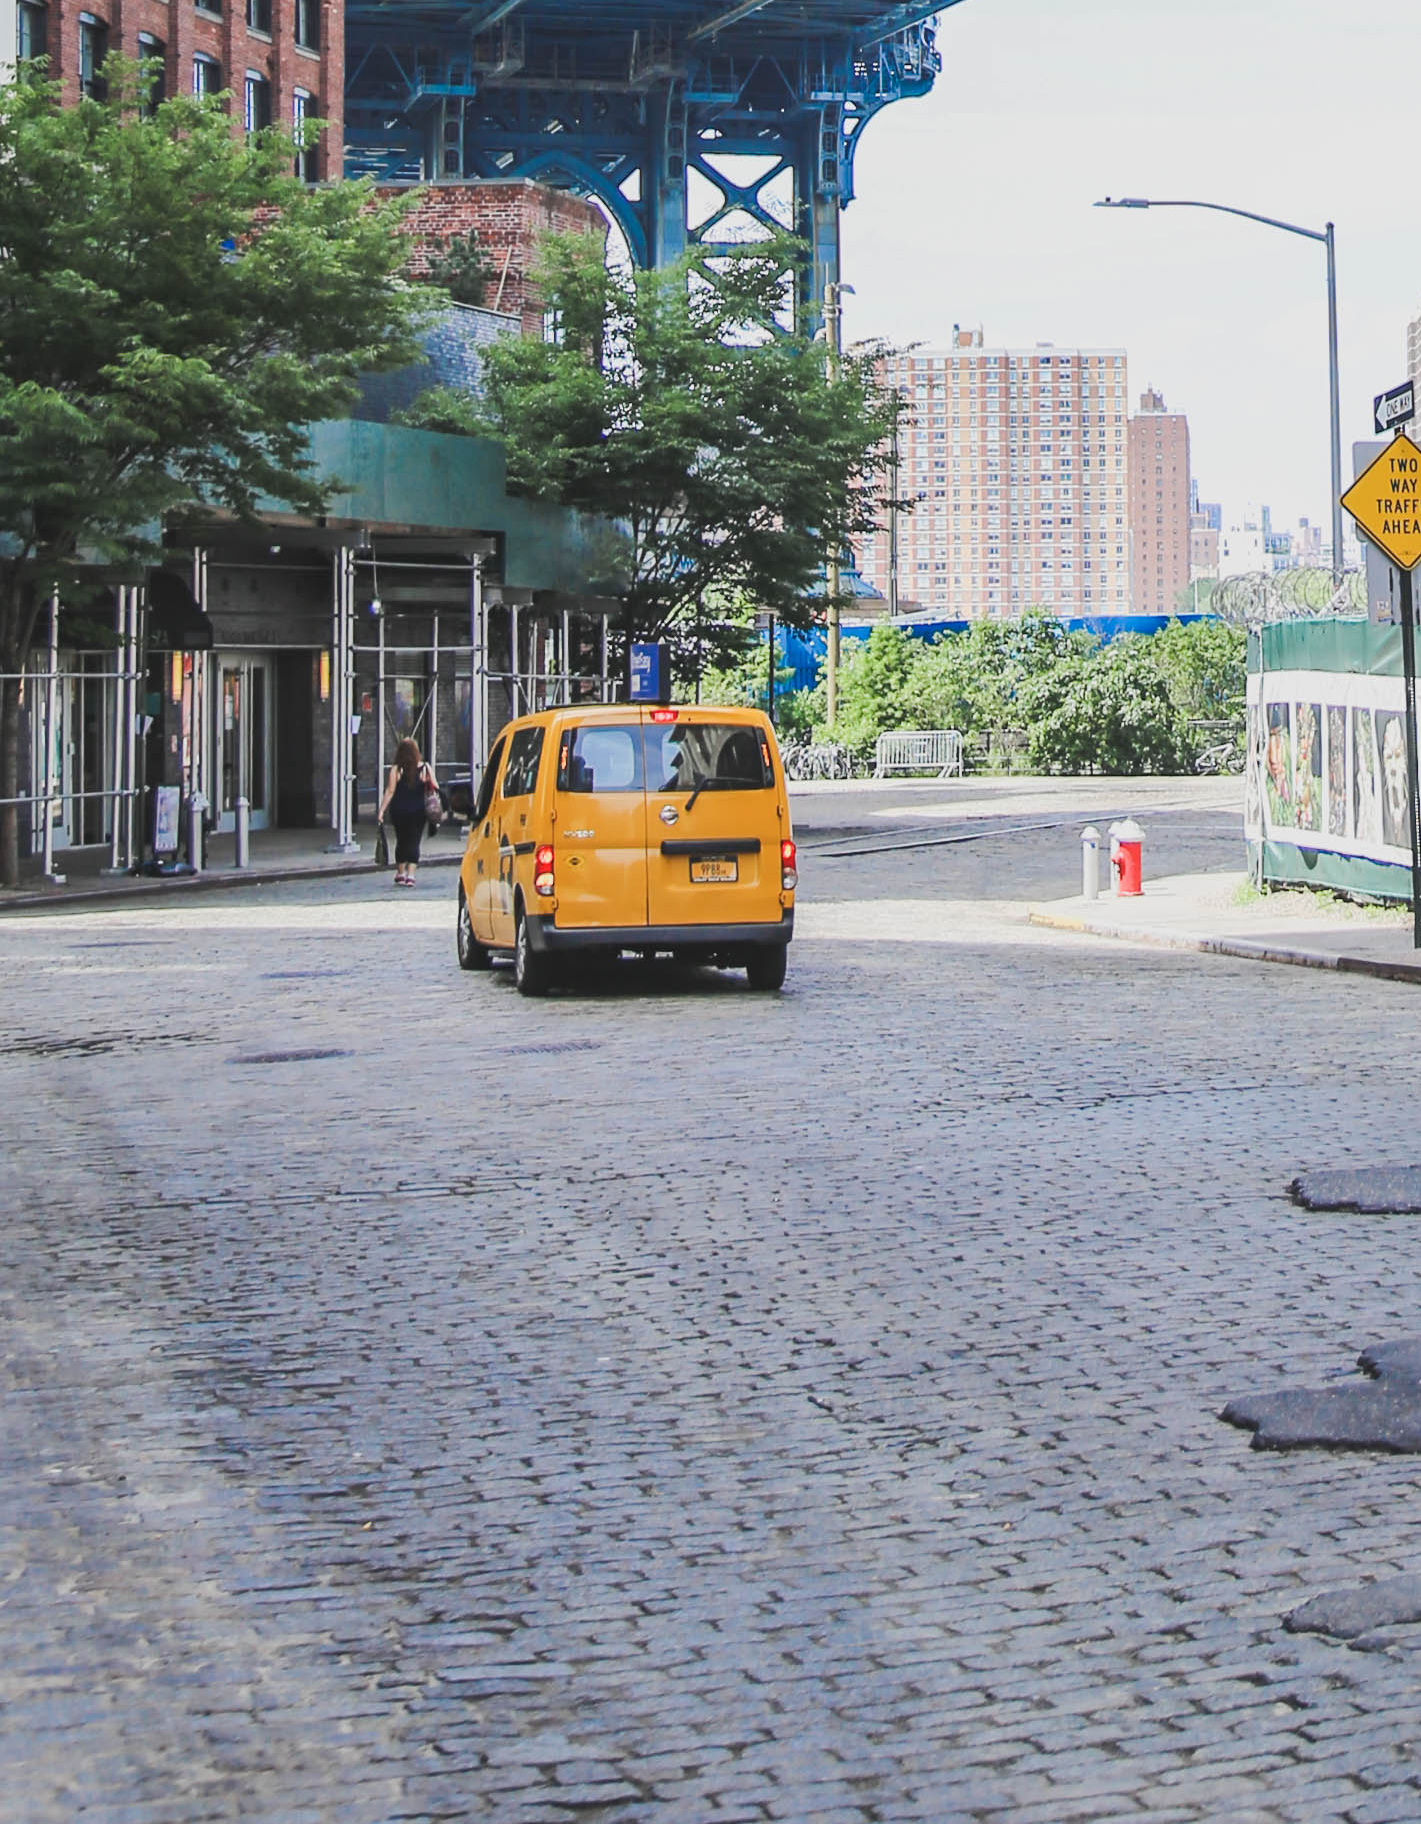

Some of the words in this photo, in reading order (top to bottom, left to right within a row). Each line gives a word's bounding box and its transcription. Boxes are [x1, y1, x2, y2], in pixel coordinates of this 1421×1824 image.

[1386, 399, 1398, 418] ONE
[1399, 394, 1411, 412] WAY
[1389, 458, 1418, 473] TWO
[1390, 478, 1418, 493] WAY
